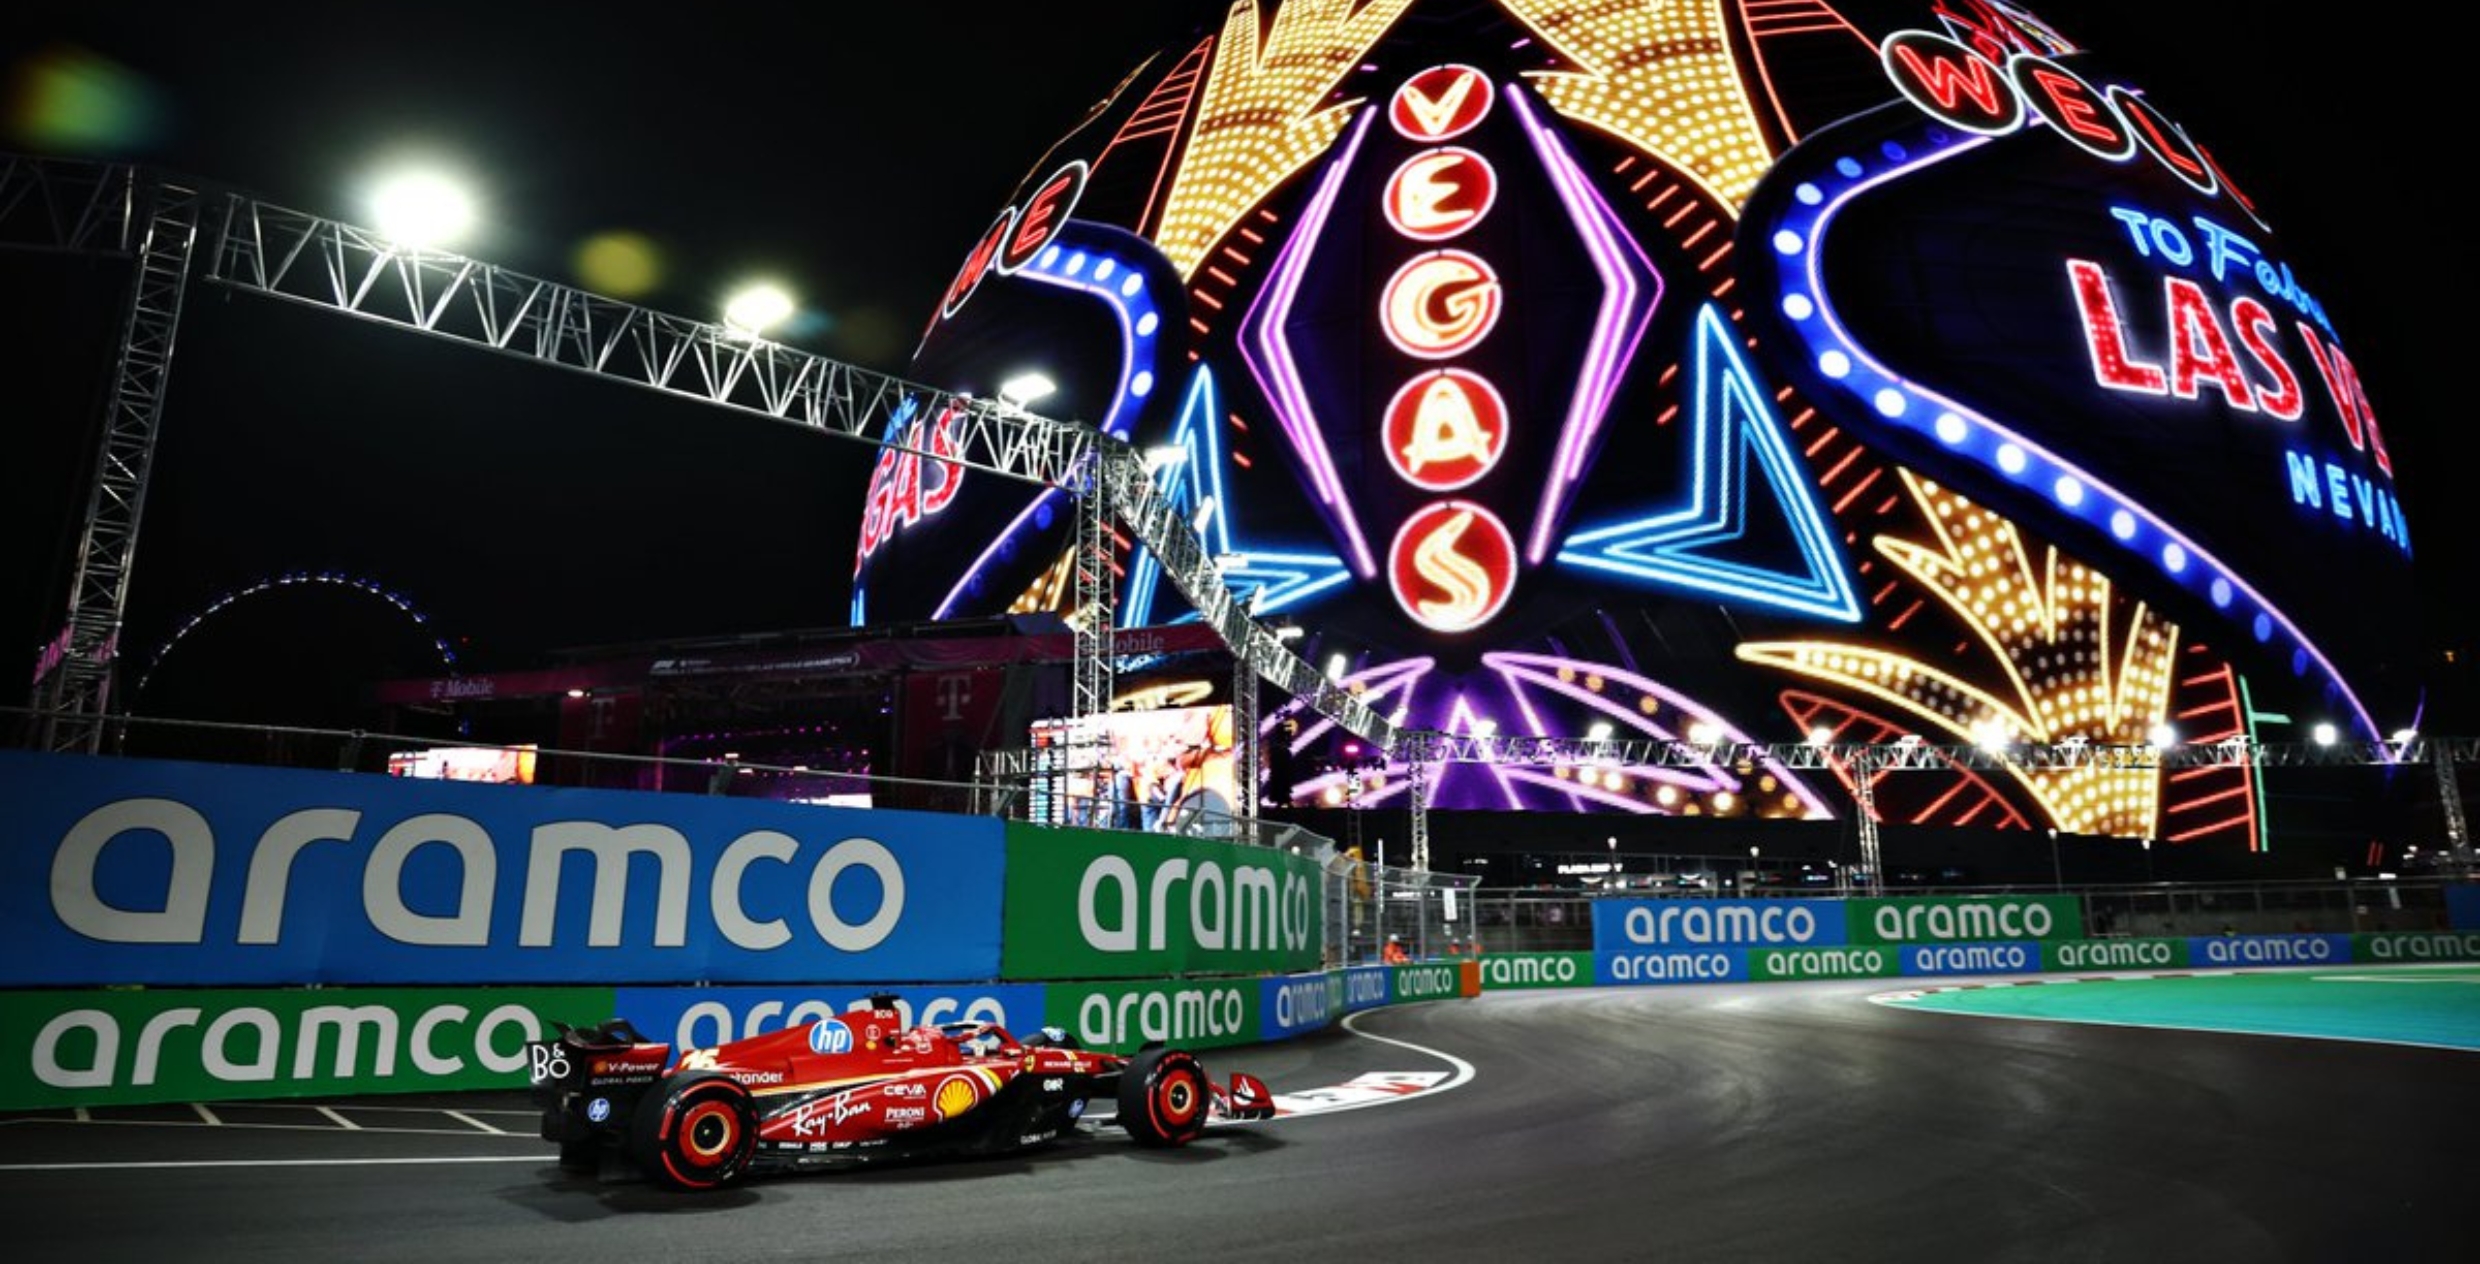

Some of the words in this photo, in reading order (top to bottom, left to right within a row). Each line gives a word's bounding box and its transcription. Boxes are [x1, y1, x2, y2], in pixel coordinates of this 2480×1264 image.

[2110, 206, 2194, 267] TO
[2193, 215, 2340, 344] Fab
[1386, 70, 1502, 632] VEGAS
[2066, 258, 2304, 422] LAS
[853, 405, 967, 580] GAS
[50, 797, 905, 948] aramco
[1079, 855, 1309, 954] aramco
[1875, 903, 2053, 939] aramco
[1625, 906, 1816, 943] aramco
[1611, 950, 1730, 979] aramco
[1767, 950, 1883, 976] aramco
[1915, 947, 2026, 971] aramco
[2057, 943, 2172, 966] aramco
[2208, 933, 2331, 962] aramco
[1399, 967, 1452, 998] aramco
[1480, 956, 1576, 983] ramco
[1080, 989, 1242, 1044] aramco
[31, 1005, 542, 1088] aramco
[813, 1019, 849, 1053] hp
[608, 1061, 660, 1073] V-Power
[731, 1072, 783, 1084] tander
[884, 1083, 926, 1096] CEVA
[792, 1090, 871, 1137] Ray-Ban
